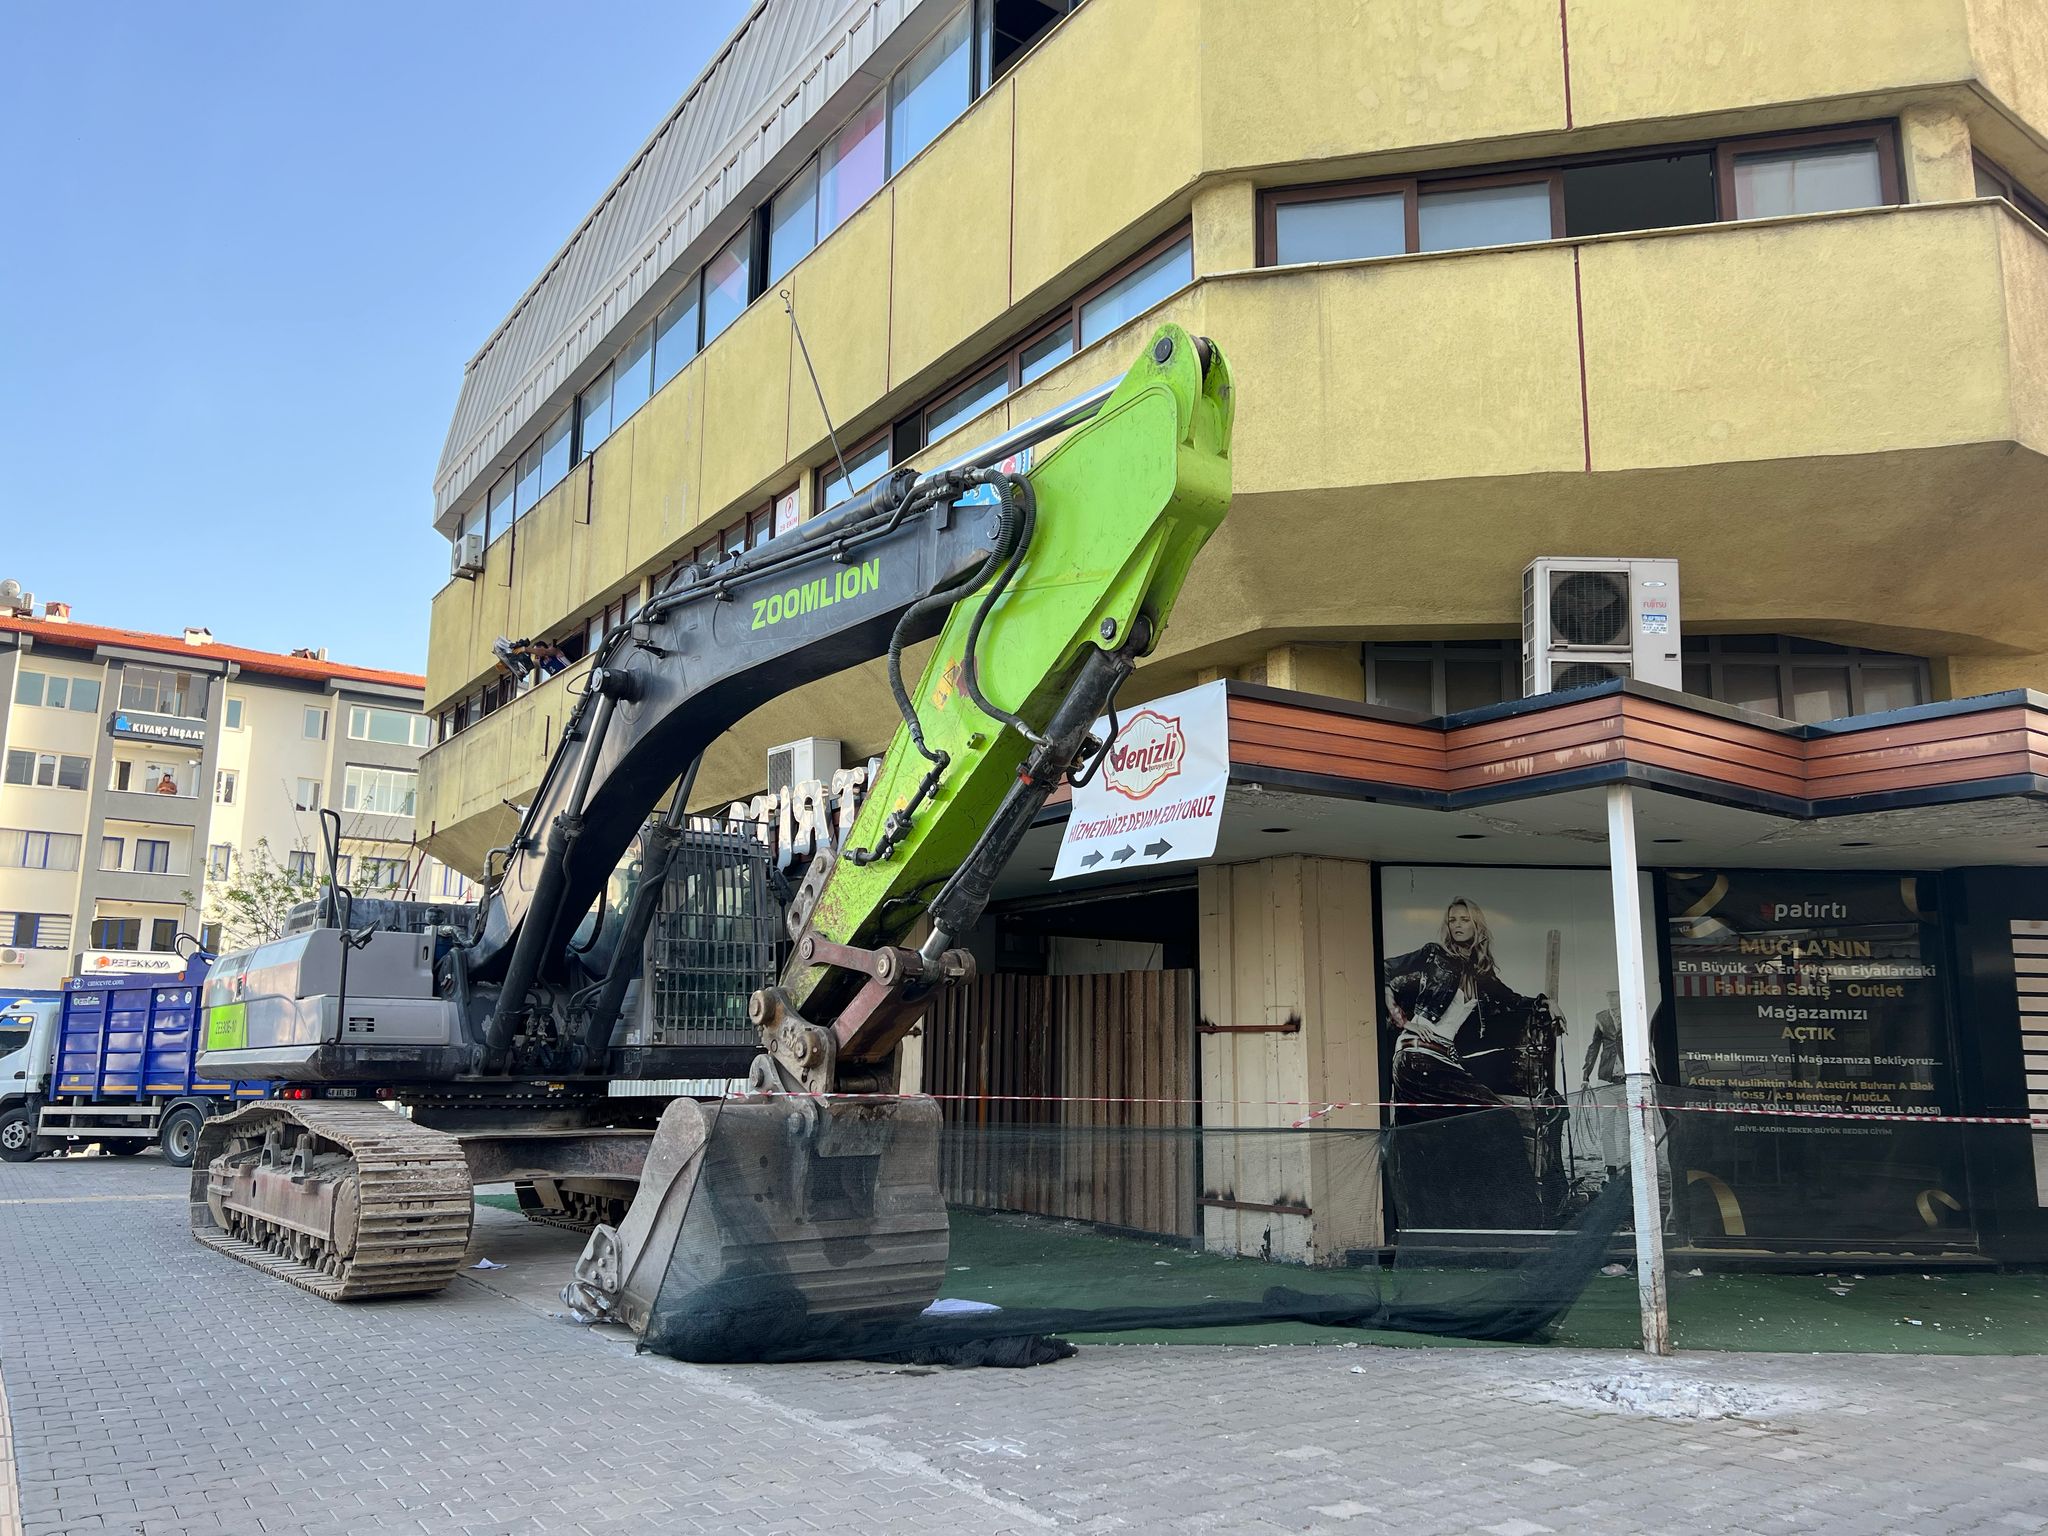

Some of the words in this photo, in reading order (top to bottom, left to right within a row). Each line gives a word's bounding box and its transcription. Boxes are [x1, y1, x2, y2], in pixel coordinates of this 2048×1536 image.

[751, 557, 881, 631] ZOOMLION
[1643, 598, 1667, 609] FUJITSU
[169, 726, 205, 740] İNŞAAT
[1113, 733, 1178, 773] denizli
[1068, 812, 1129, 844] HİZMETİNİZE
[1125, 809, 1162, 833] DEVAM
[1159, 795, 1216, 822] EDİYORUZ
[1774, 901, 1847, 922] patırtı
[1741, 935, 1872, 957] MUĞLA'NIN
[1678, 960, 1697, 972] En
[1701, 960, 1748, 975] Büyük
[1754, 962, 1773, 974] Ve
[1777, 963, 1796, 975] En
[1851, 962, 1937, 978] Fiyatlardaki
[1715, 980, 1782, 996] Fabrika
[1786, 982, 1832, 1000] Satış
[1846, 983, 1905, 998] Outlet
[1757, 1004, 1868, 1022] Mağazamızı
[1781, 1026, 1836, 1043] AÇTIK
[1686, 1051, 1712, 1061] Tüm
[1715, 1052, 1768, 1062] Halkımızı
[1771, 1053, 1796, 1063] Yeni
[1799, 1054, 1871, 1065] Mağazamıza
[1688, 1076, 1726, 1086] Adres:
[1728, 1078, 1785, 1088] Muslihittin
[1787, 1079, 1814, 1089] Mah.
[1816, 1080, 1857, 1090] Atatürk
[1899, 1082, 1908, 1090] A
[1910, 1082, 1935, 1091] Blok
[1796, 1092, 1843, 1103] Menteşe
[1853, 1092, 1891, 1102] MUĞLA
[1795, 1104, 1843, 1113] BELLONA
[1851, 1105, 1905, 1114] TURKCELL
